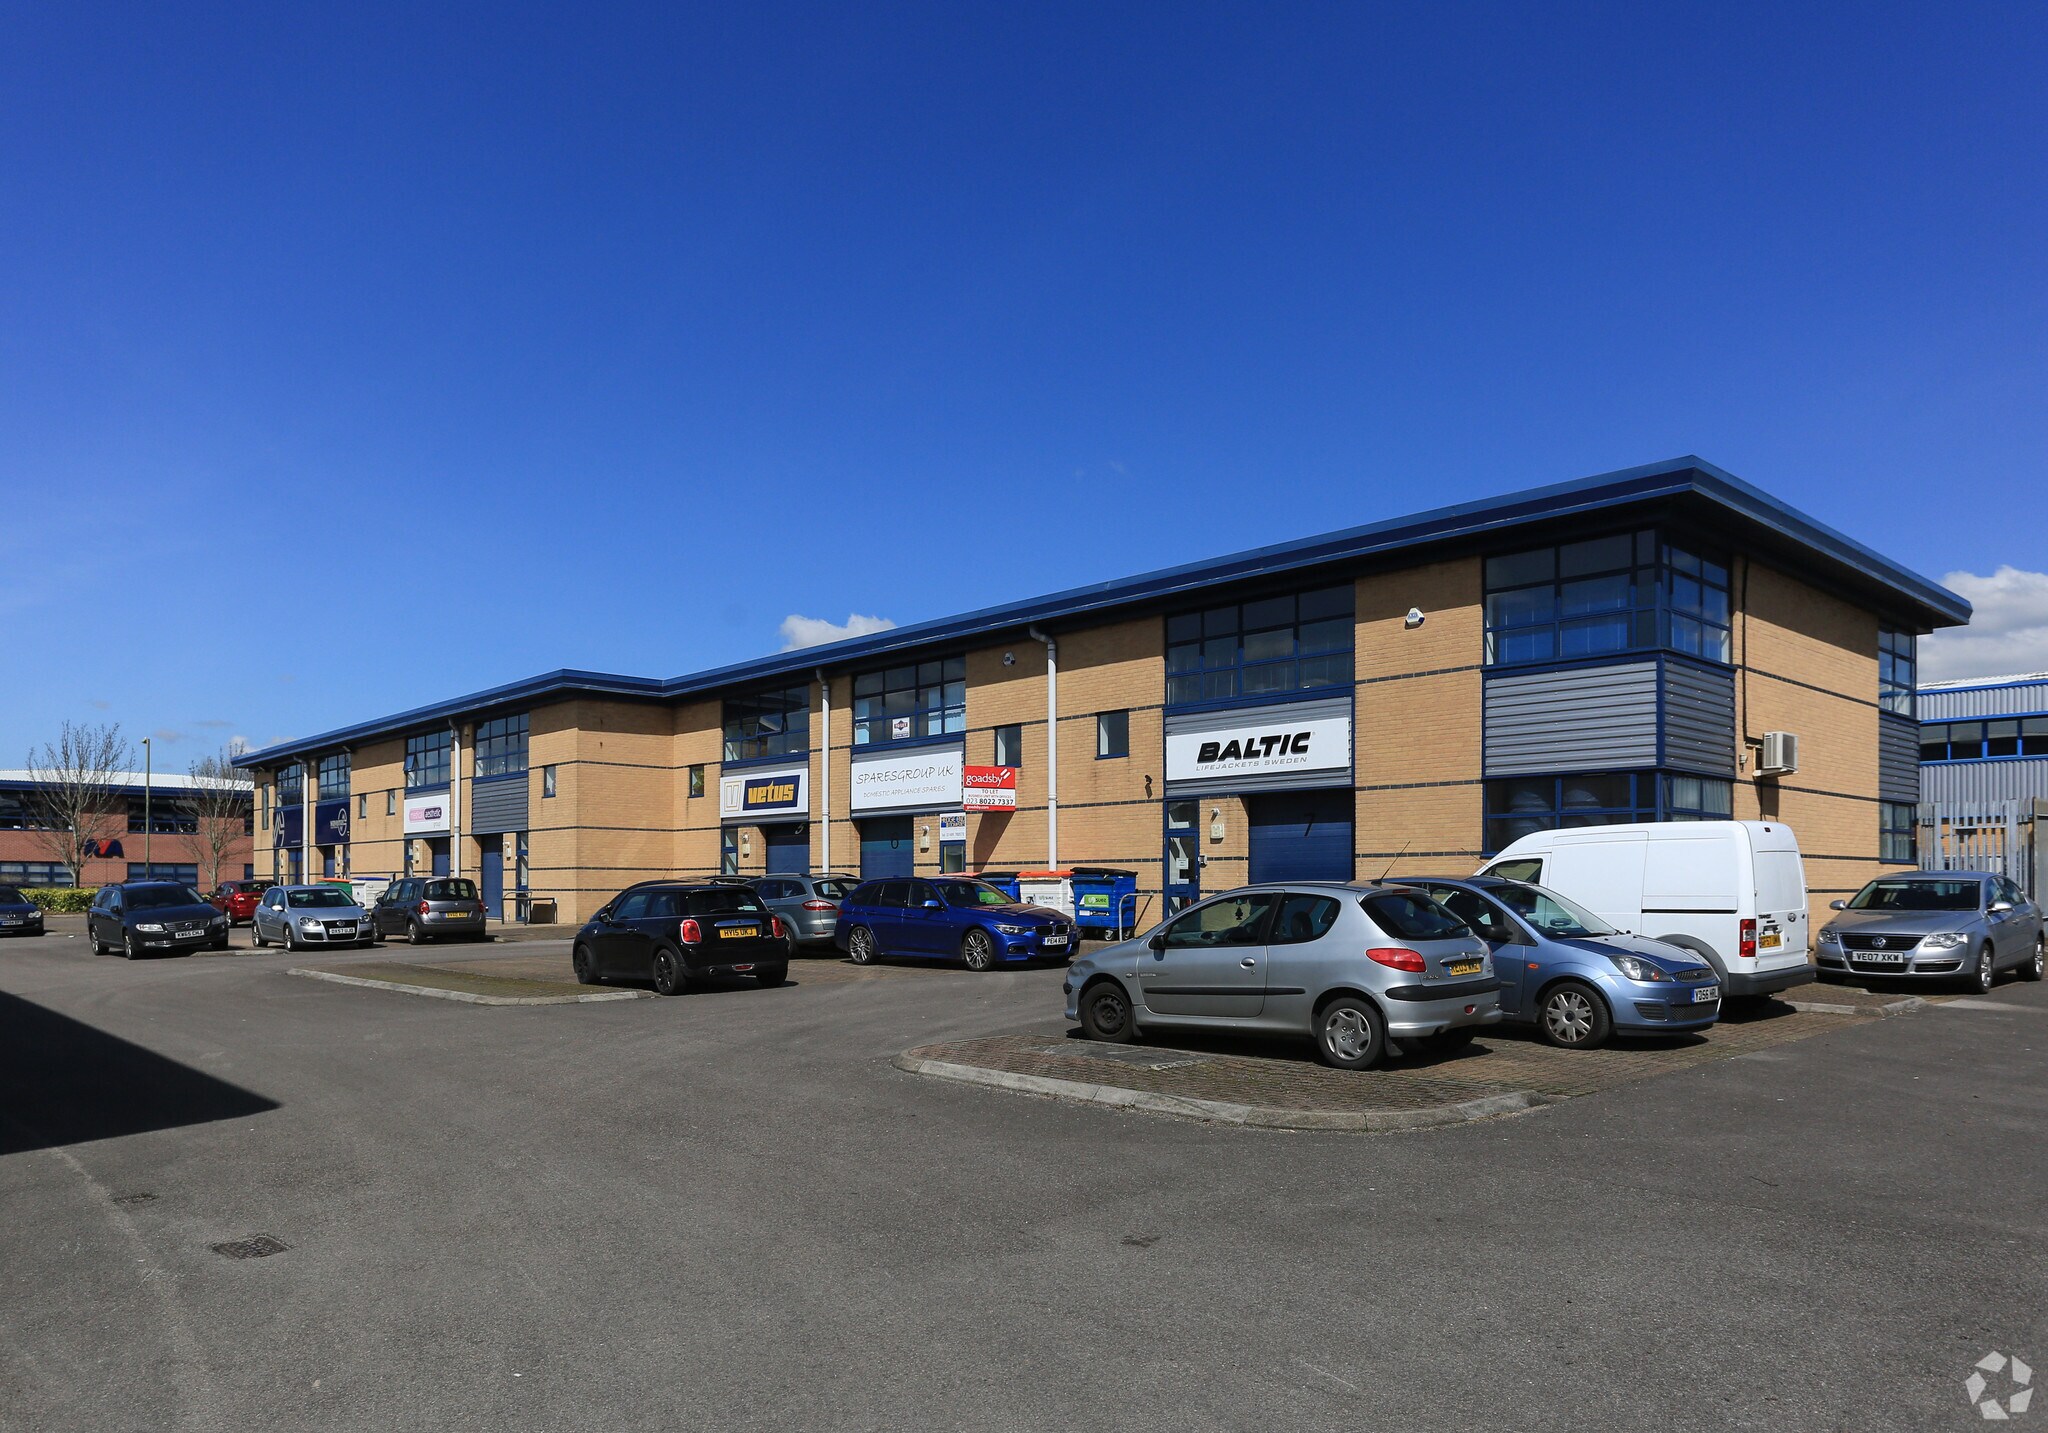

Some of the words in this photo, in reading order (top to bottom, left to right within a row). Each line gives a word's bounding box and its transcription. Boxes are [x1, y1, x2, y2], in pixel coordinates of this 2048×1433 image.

[1197, 731, 1311, 764] BALTIC
[1196, 761, 1260, 771] LIFEJACKETS
[1264, 757, 1308, 766] SWEDEN
[856, 766, 935, 785] SPARESGROUP
[937, 765, 954, 777] UK
[966, 772, 1003, 787] goadsby
[748, 781, 795, 804] vetus
[863, 789, 891, 798] DOMESTIC
[891, 787, 921, 796] APPLIANCE
[921, 785, 946, 794] SPARES
[1304, 812, 1316, 837] 7
[1856, 953, 1878, 961] VE07
[1881, 954, 1899, 962] XKW
[1696, 988, 1708, 1000] YD56
